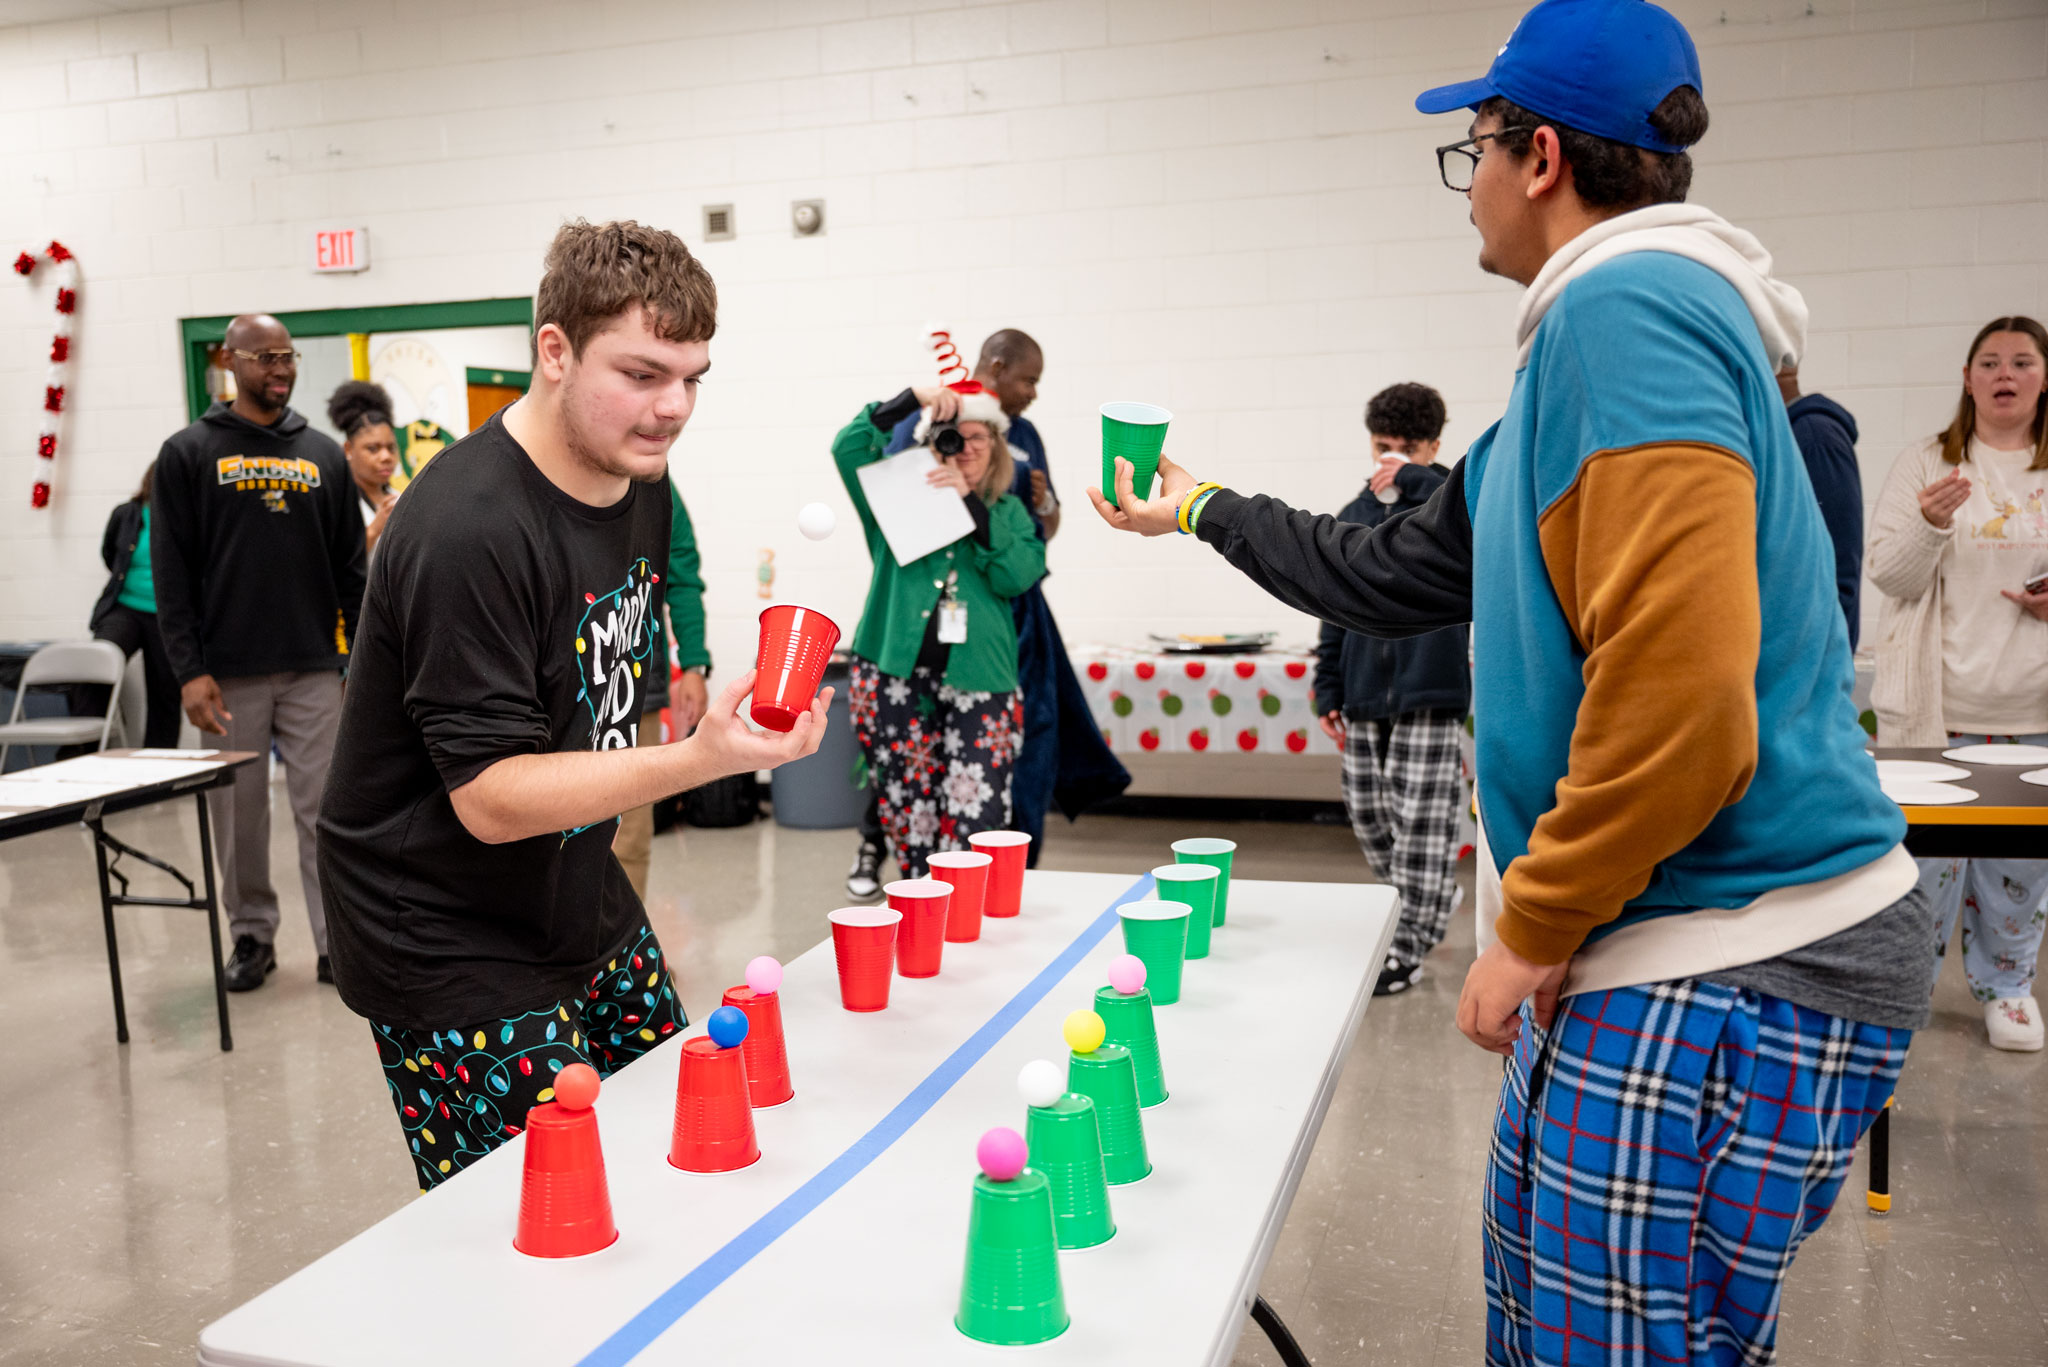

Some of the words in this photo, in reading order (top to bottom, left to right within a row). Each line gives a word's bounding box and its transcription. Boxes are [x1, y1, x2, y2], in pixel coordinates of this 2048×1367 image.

[316, 230, 355, 268] EXIT
[217, 454, 321, 488] ENCSD
[590, 581, 651, 686] MRRY
